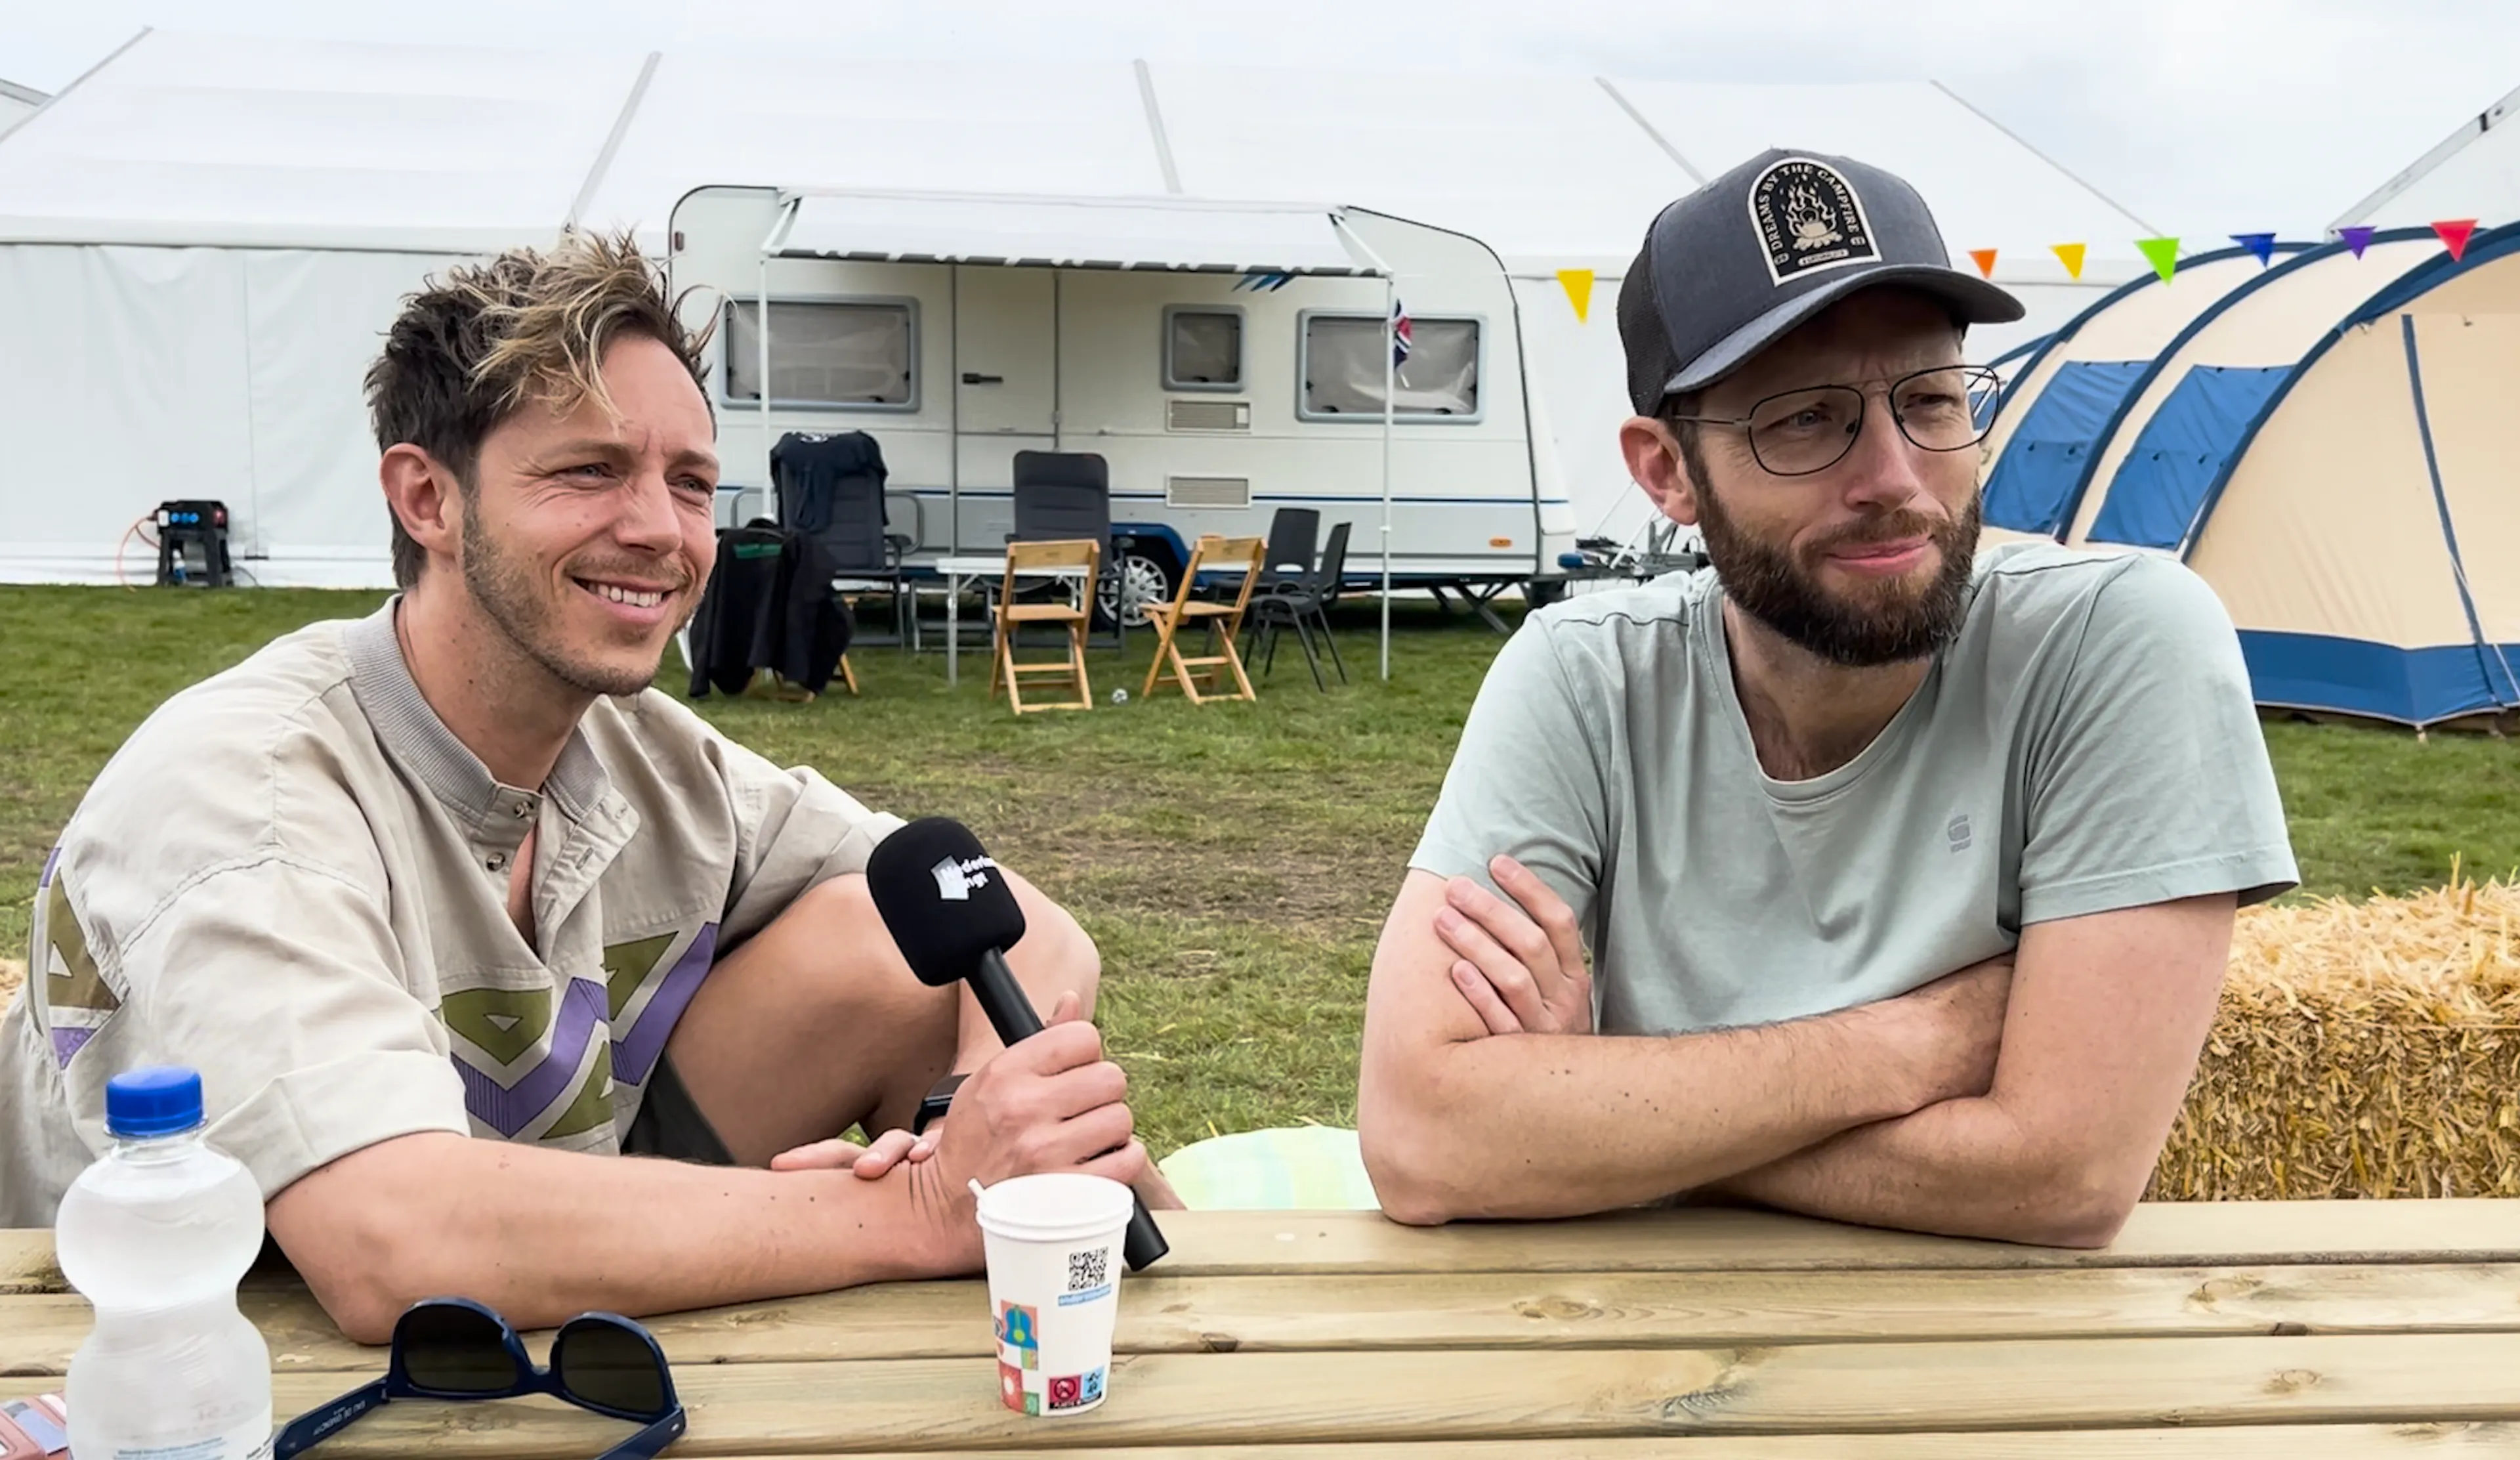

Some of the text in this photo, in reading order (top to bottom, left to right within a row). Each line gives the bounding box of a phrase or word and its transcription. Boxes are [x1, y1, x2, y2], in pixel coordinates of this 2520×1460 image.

[1758, 164, 1859, 249] DREAMS BY THE CAMPFIRE
